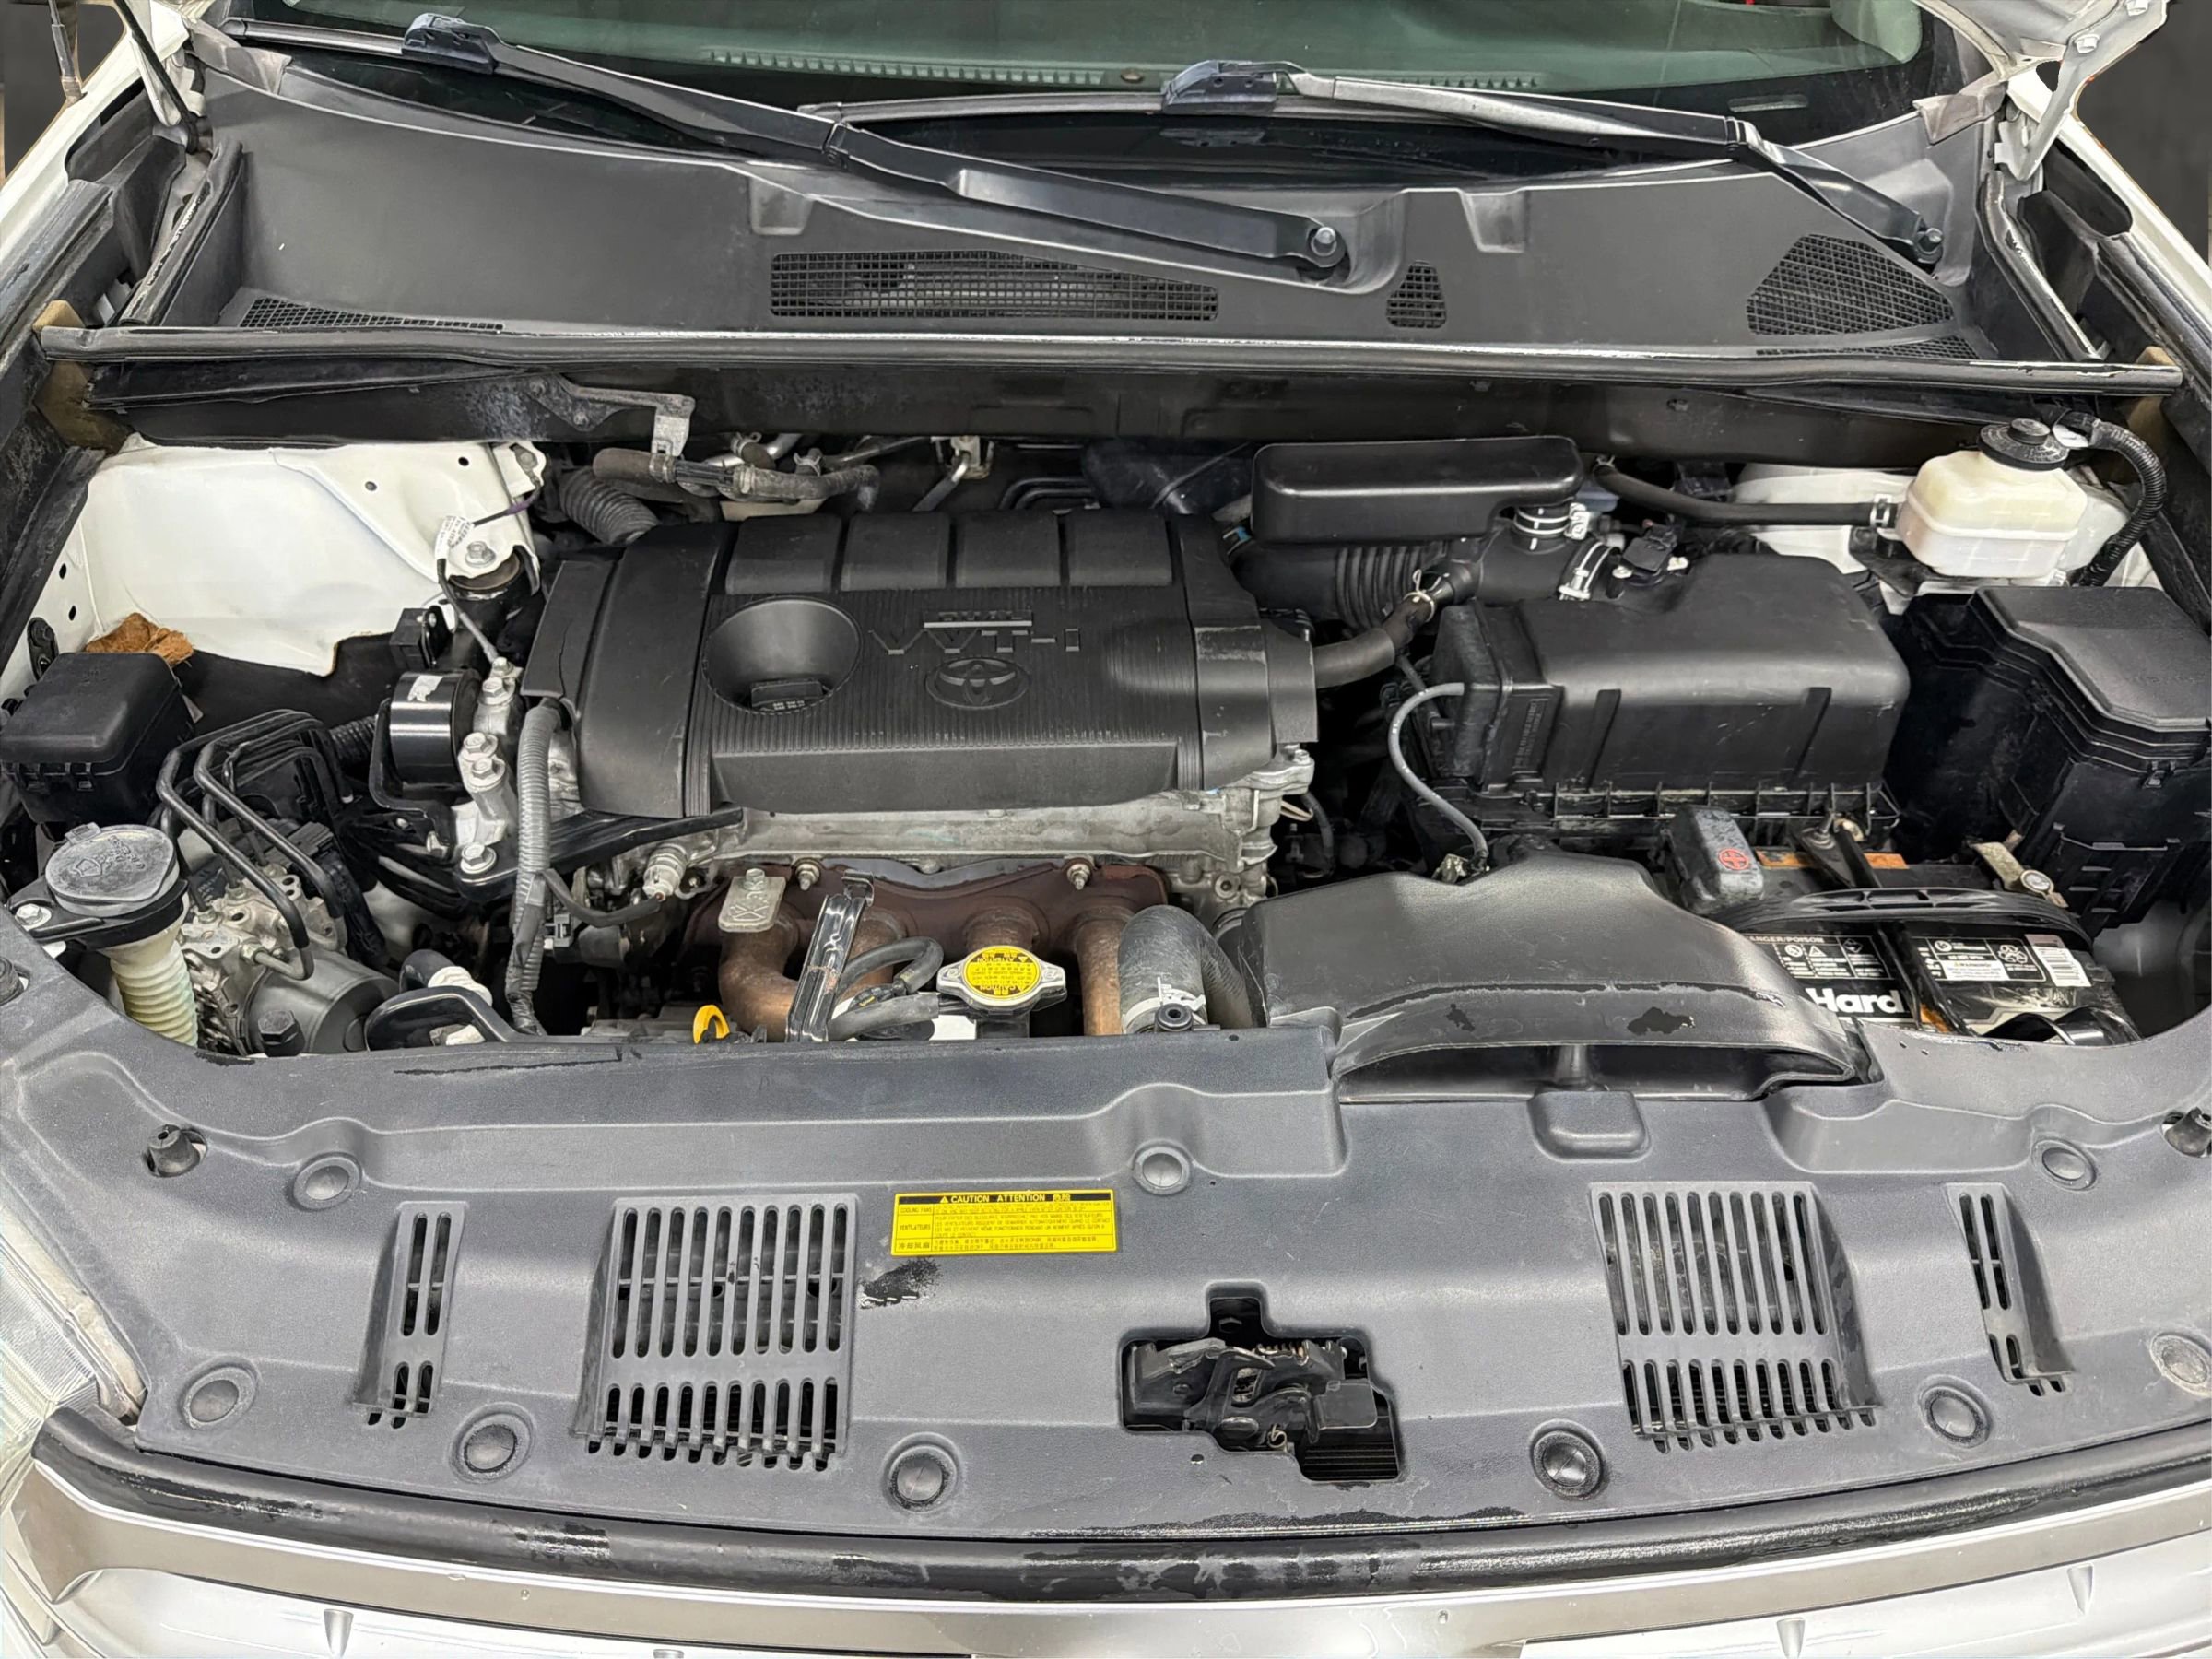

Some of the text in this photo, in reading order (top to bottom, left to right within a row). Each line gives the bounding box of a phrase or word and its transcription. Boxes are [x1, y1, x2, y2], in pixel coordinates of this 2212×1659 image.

[1747, 935, 1825, 944] ANGER/POISON
[950, 1194, 1046, 1204] CAUTION ATTENTION
